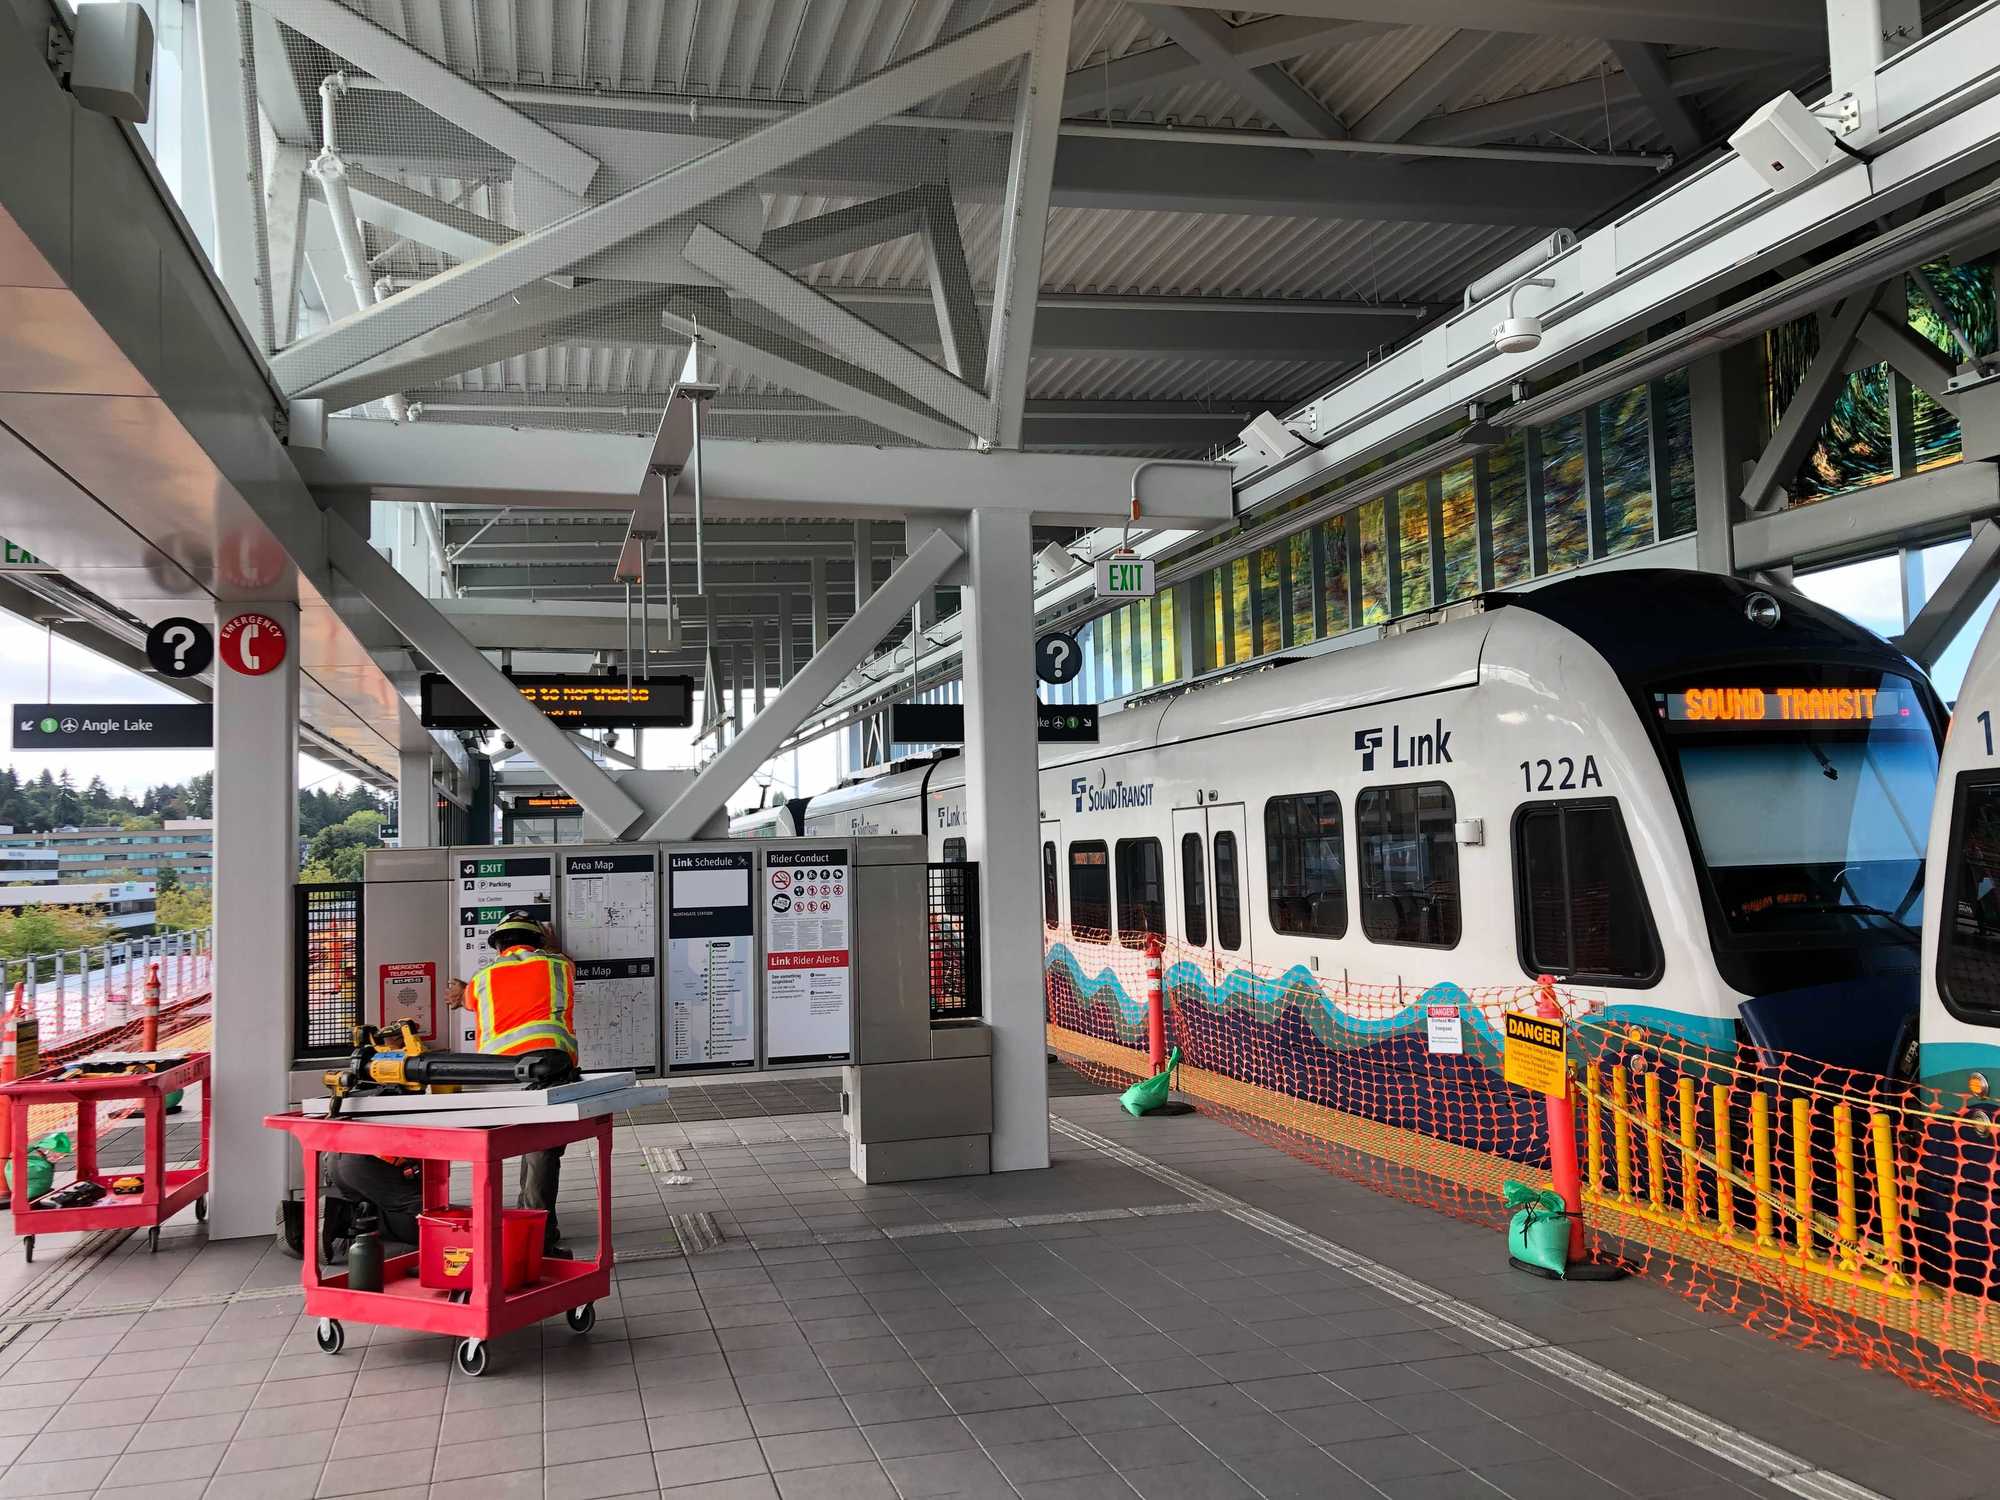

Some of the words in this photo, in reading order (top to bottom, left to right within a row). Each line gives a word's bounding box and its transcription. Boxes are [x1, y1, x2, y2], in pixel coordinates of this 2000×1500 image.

[1109, 564, 1143, 591] EXIT
[221, 615, 283, 639] EMERGENCY
[1685, 688, 1765, 720] SOUND
[1777, 687, 1877, 720] TRANSIT
[82, 719, 119, 734] Angle
[124, 719, 153, 731] Lake
[1037, 716, 1050, 728] ke
[1393, 718, 1453, 769] Link
[1519, 754, 1603, 793] 122A
[672, 857, 693, 867] Link
[695, 857, 733, 867] Schedule
[770, 854, 792, 864] Rider
[794, 853, 829, 862] Conduct
[480, 864, 502, 873] EXIT
[571, 861, 592, 870] Area
[594, 860, 614, 871] Map
[489, 881, 512, 889] Parking
[481, 911, 502, 920] EXIT
[771, 956, 791, 966] Link
[793, 955, 814, 965] Rider
[816, 954, 840, 964] Alerts
[576, 966, 589, 976] ike
[592, 966, 612, 977] Map
[1431, 1007, 1455, 1016] DANGER
[1509, 1018, 1561, 1047] DANGER
